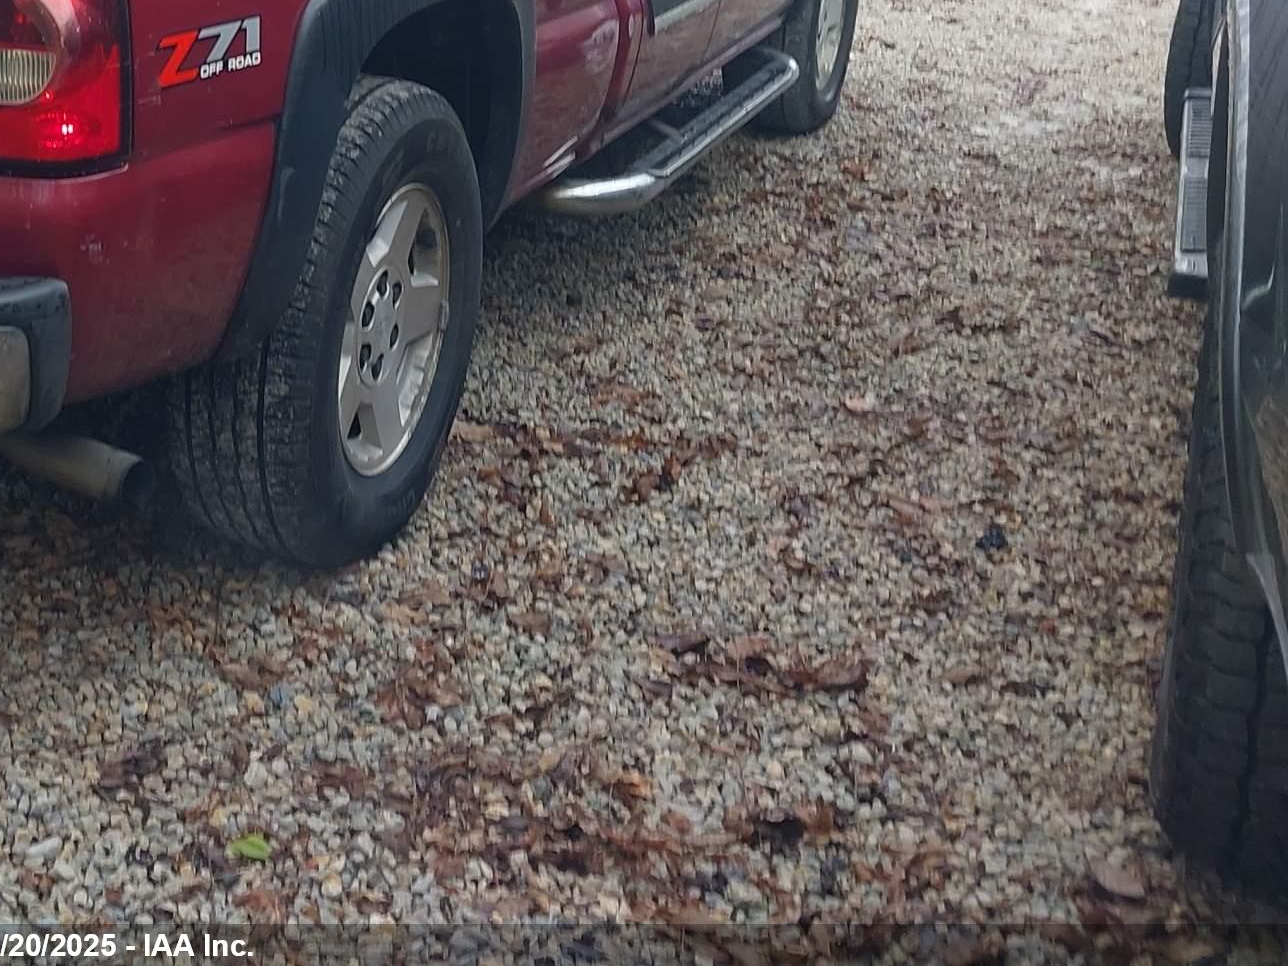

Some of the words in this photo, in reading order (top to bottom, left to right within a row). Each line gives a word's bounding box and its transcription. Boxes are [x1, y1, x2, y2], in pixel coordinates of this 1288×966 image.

[158, 15, 261, 88] Z71
[200, 61, 224, 80] OFF
[227, 52, 262, 72] ROAD
